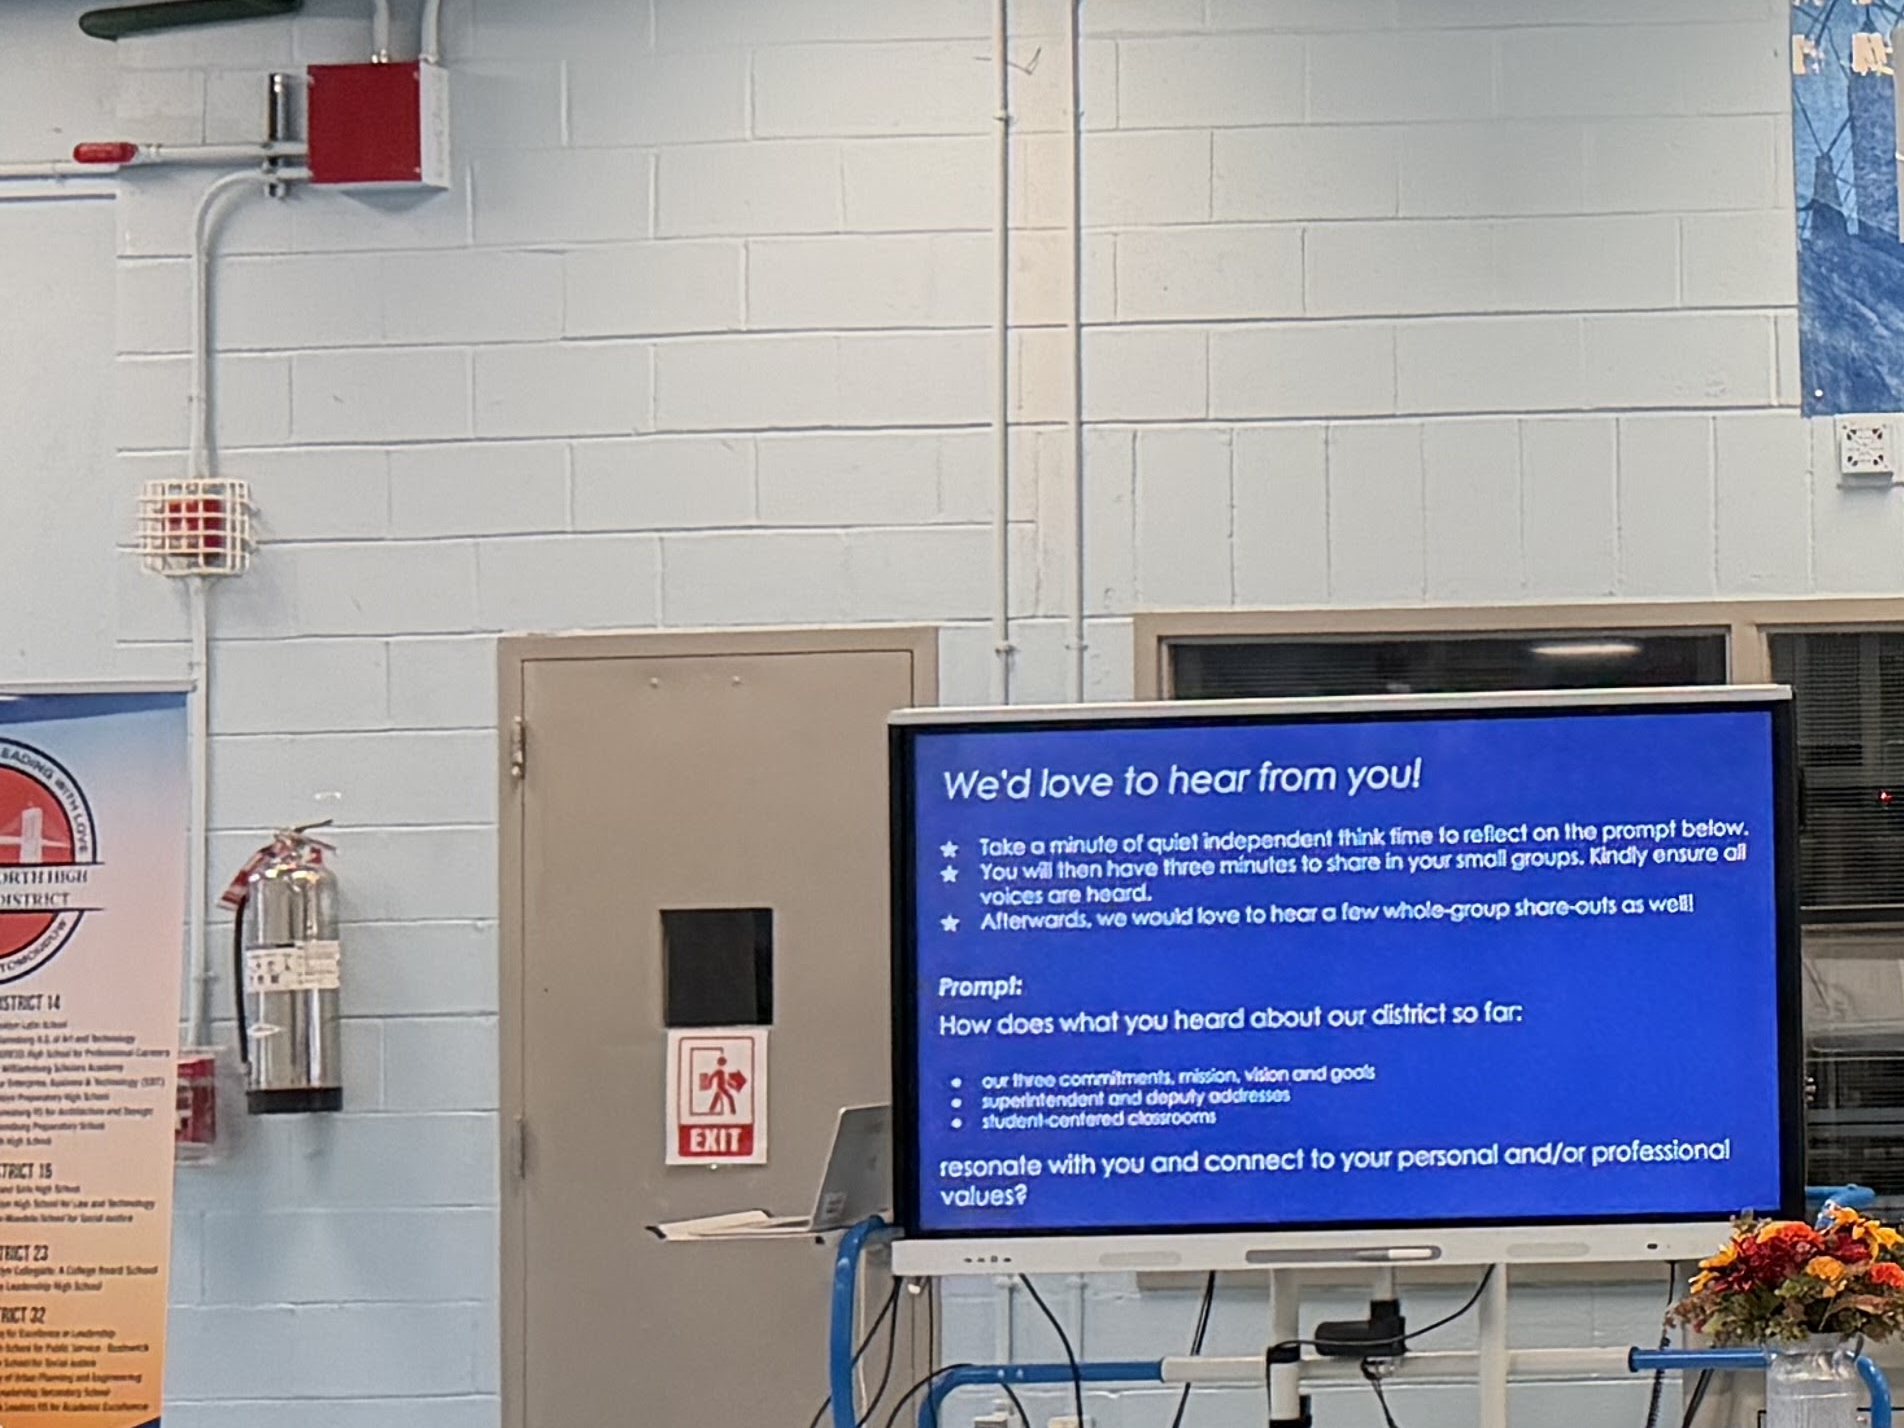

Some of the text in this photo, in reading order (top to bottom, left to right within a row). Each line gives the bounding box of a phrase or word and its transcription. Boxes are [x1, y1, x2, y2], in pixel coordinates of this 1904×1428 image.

[943, 756, 1422, 801] We'd love to hear from you!
[978, 817, 1750, 857] Take a minute of quiet independent think time to reflect on the prompt below.
[979, 841, 1747, 882] You will then have three minutes to share in your small groups. Kindly ensure all
[47, 869, 88, 884] HIGH
[979, 881, 1153, 907] voices are heard.
[980, 893, 1694, 932] Afterwards, we would love to hear a few whole-group share-outs as well!
[938, 974, 1023, 1001] Prompt:
[47, 993, 61, 1010] 14
[939, 1000, 1523, 1037] How does what you heard about our district so far:
[981, 1063, 1376, 1090] our three commitments, mission, vision and goals
[981, 1087, 1291, 1112] superintendent and deputy addresses
[689, 1128, 742, 1153] EXIT
[39, 1163, 53, 1179] 15
[939, 1137, 1731, 1179] resonate with you and connect to your personal and/or professional
[940, 1182, 1028, 1208] values?
[33, 1244, 49, 1261] 23
